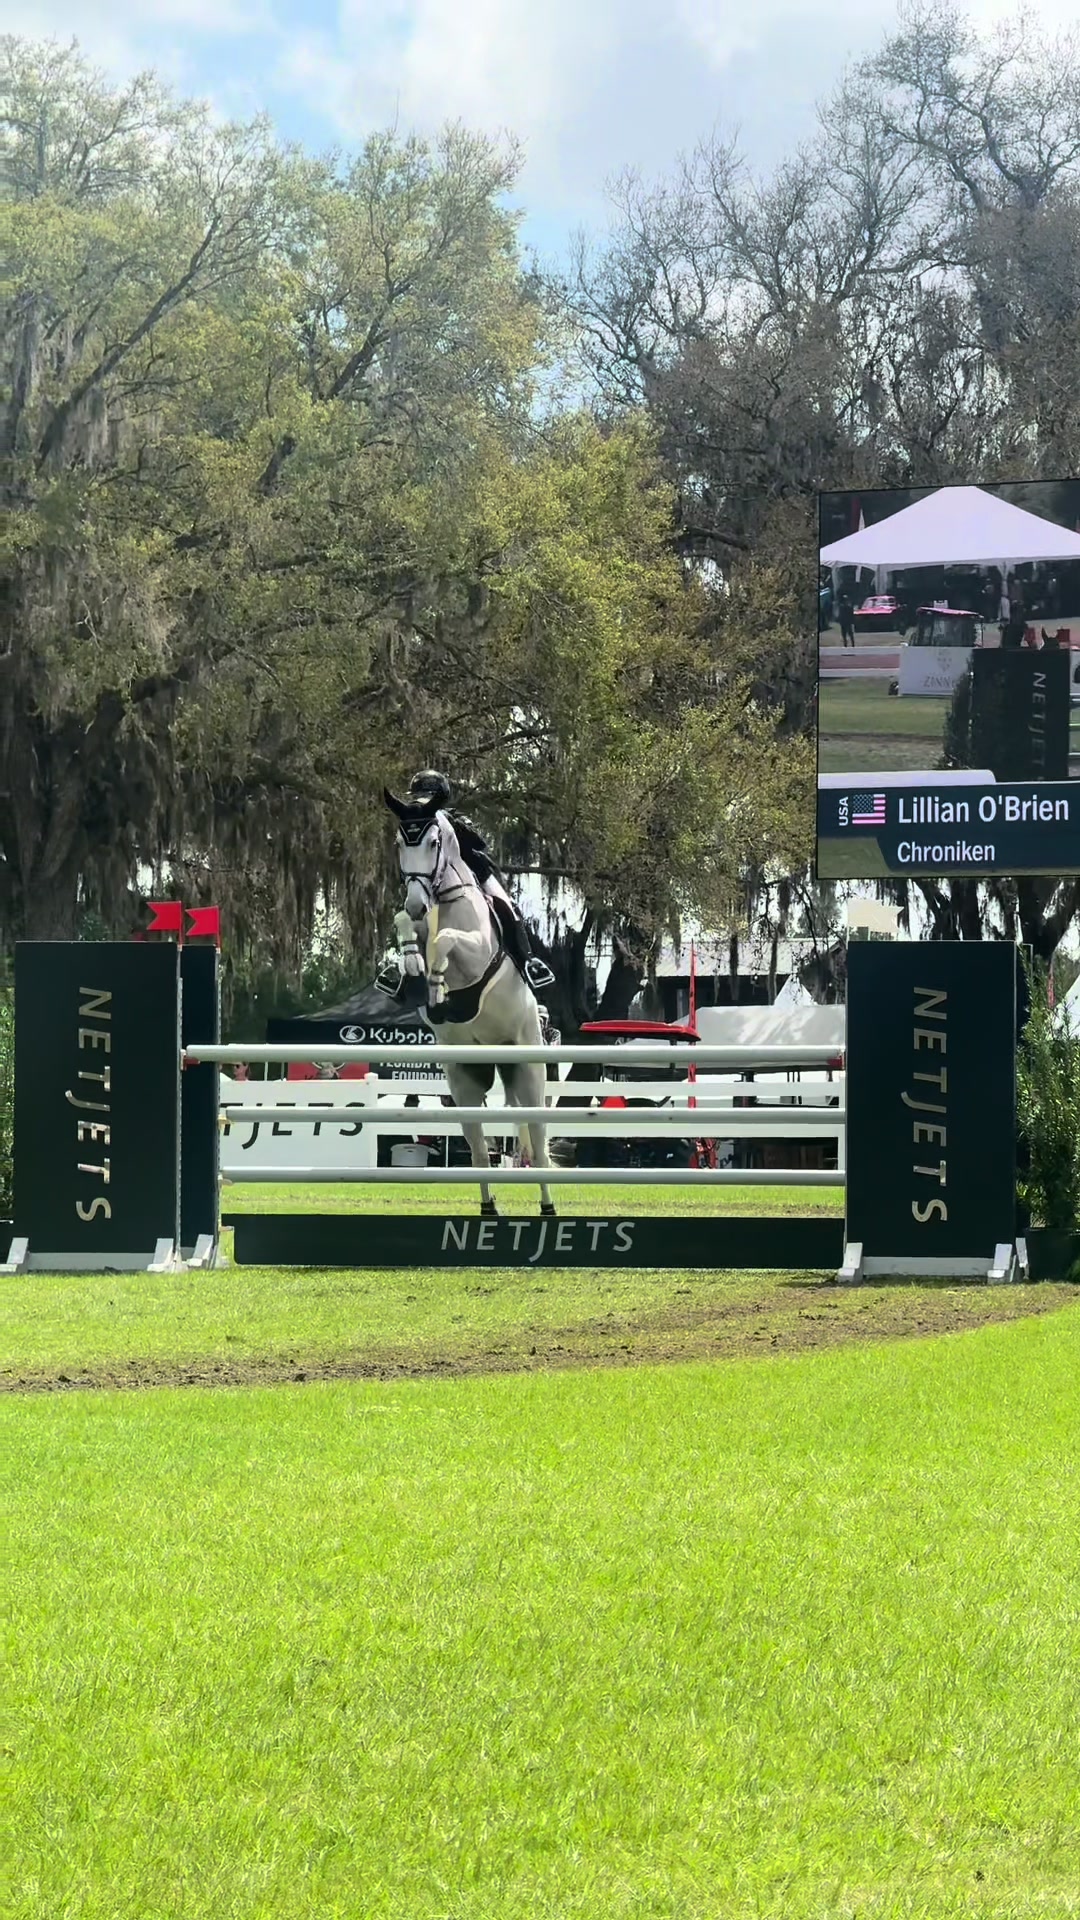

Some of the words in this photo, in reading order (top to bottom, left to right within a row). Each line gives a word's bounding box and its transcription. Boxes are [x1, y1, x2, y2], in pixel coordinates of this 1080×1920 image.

[1028, 671, 1047, 781] NETJET
[838, 796, 849, 826] USA
[898, 796, 970, 824] Lillian
[978, 794, 1070, 823] O'Brien
[897, 841, 996, 863] Chroniken
[369, 1027, 436, 1045] Kubota
[65, 986, 112, 1222] NETJETS
[900, 986, 948, 1223] NETJETS
[440, 1220, 636, 1263] NETJETS
